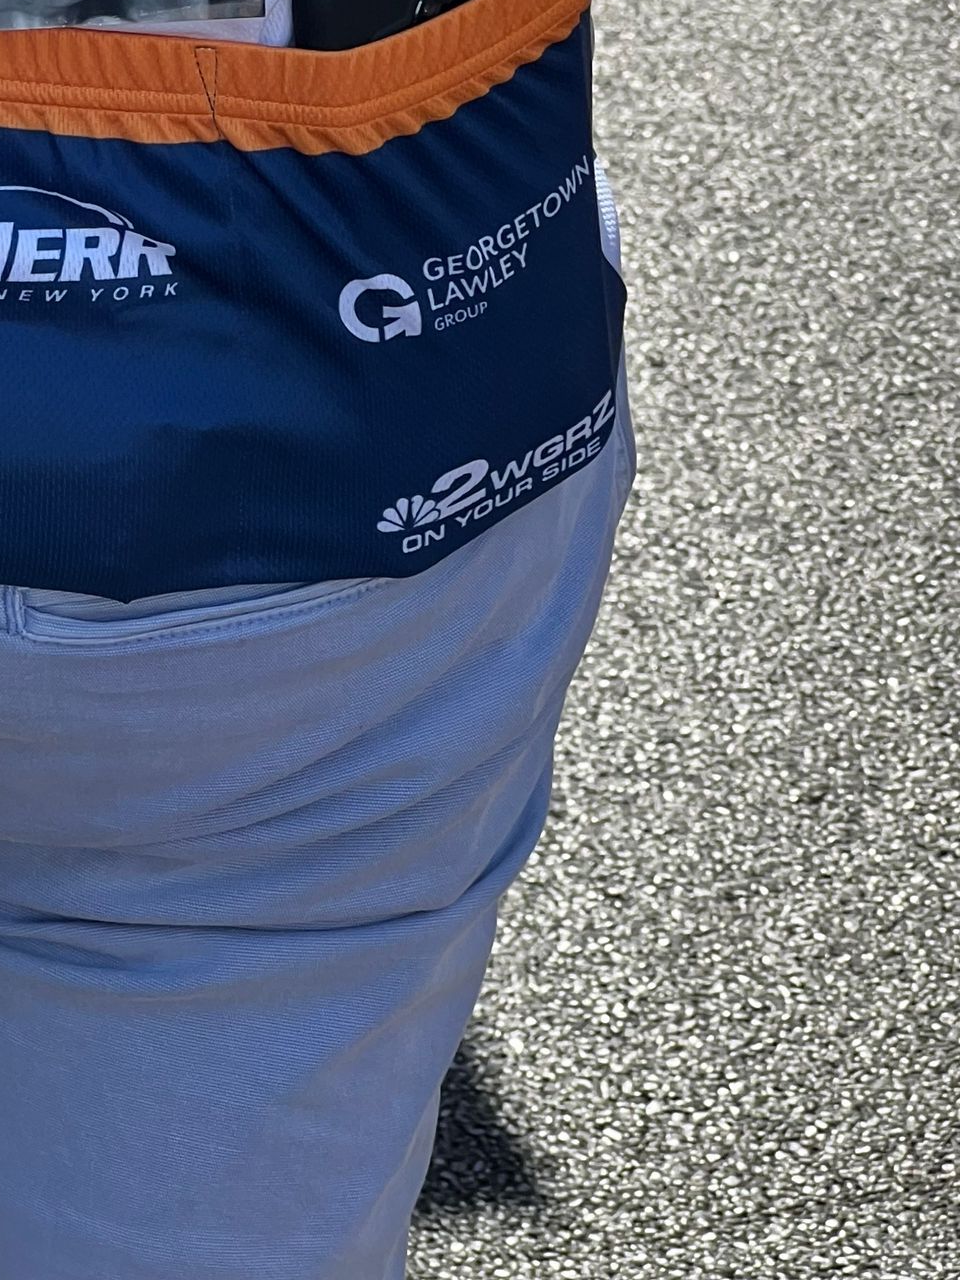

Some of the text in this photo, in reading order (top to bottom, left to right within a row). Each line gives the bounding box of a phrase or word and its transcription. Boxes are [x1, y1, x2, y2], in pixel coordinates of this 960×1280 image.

[422, 155, 590, 281] GEORGETOWN
[90, 282, 179, 302] YORK
[427, 242, 528, 311] LAWLEY
[434, 301, 488, 331] GROUP
[402, 436, 602, 553] ON YOUR SIDE
